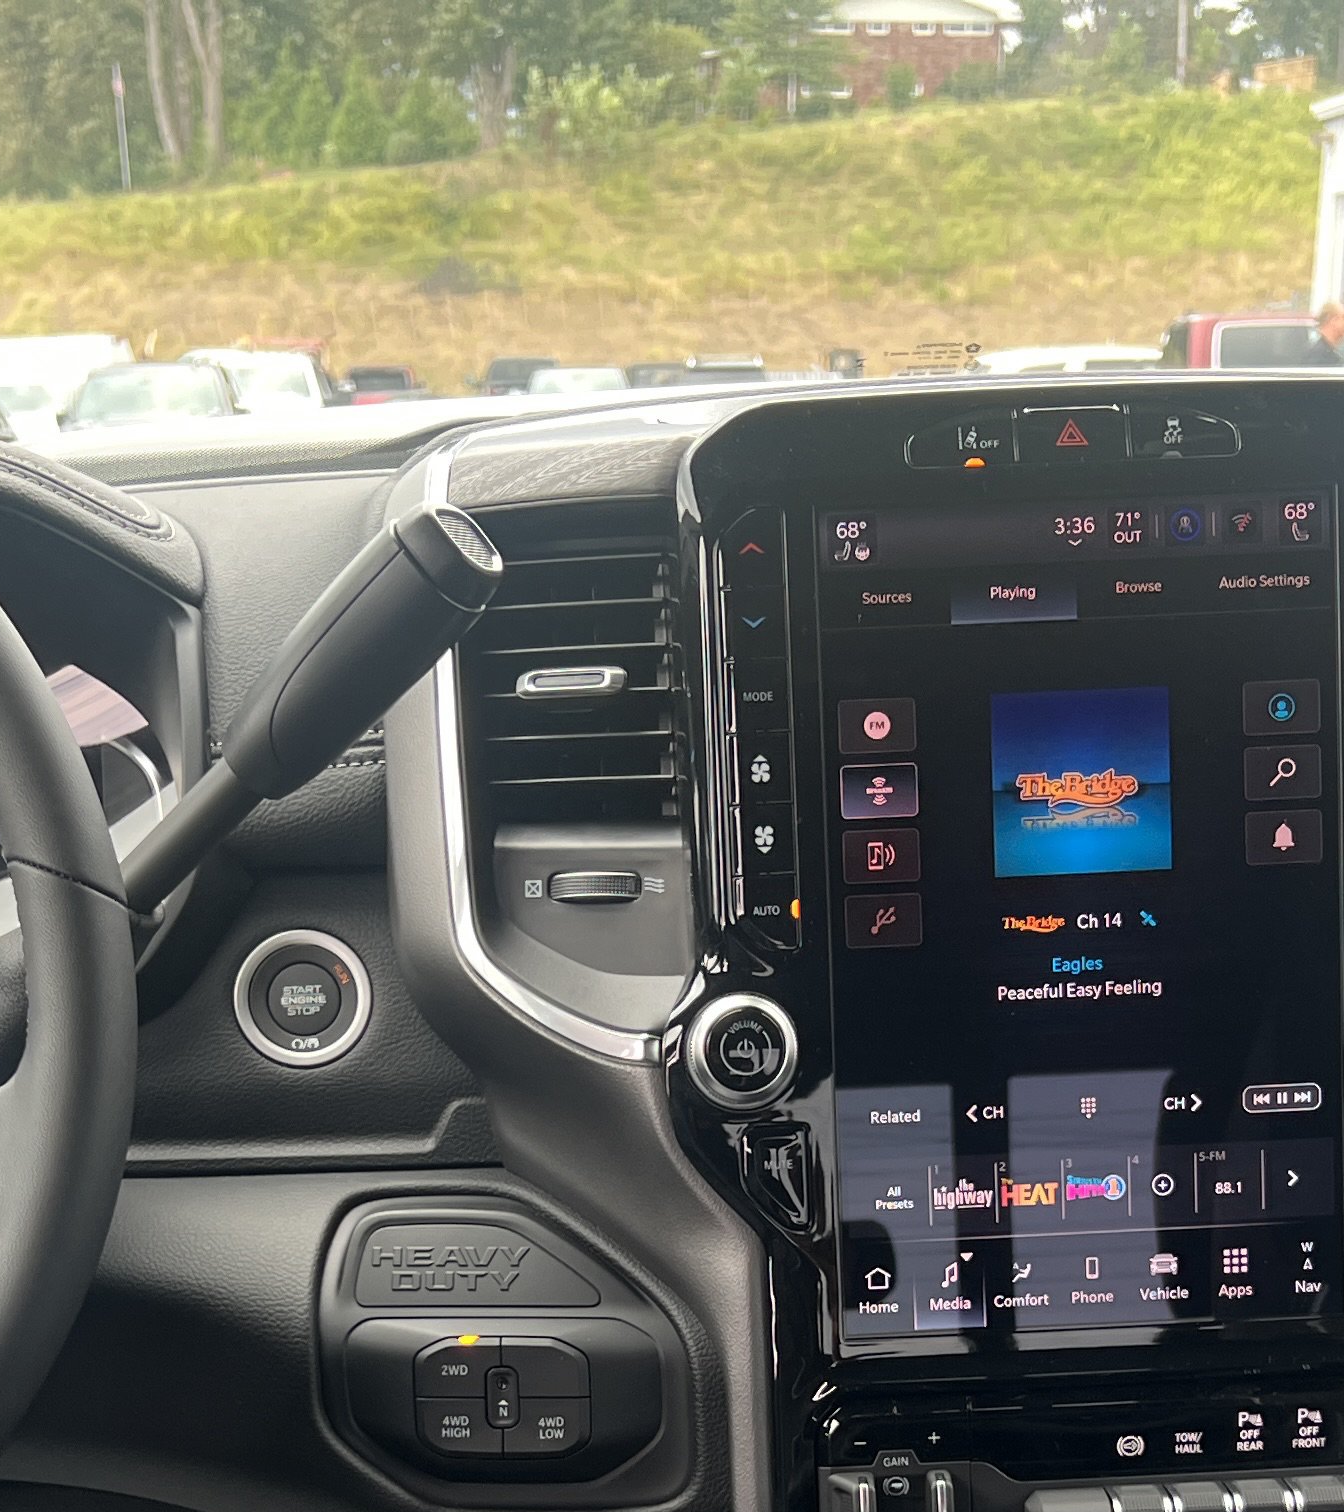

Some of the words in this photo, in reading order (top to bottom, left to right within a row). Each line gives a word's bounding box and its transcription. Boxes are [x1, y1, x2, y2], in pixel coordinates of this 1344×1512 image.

[980, 440, 999, 449] OFF
[1164, 436, 1183, 445] OFF
[1054, 517, 1095, 535] 3:36
[1114, 531, 1141, 543] OUT
[1116, 581, 1162, 594] Browse
[1219, 575, 1256, 589] Audio
[1259, 574, 1310, 588] Settings
[862, 591, 911, 604] Sources
[990, 586, 1036, 601] Playing
[743, 691, 773, 702] MODE
[870, 721, 884, 730] FM
[753, 905, 780, 916] AUTO
[1077, 914, 1098, 929] Ch
[1104, 913, 1122, 928] 14
[1052, 956, 1103, 974] Eagles
[283, 985, 322, 994] START
[997, 983, 1063, 1001] Peaceful
[1066, 982, 1102, 1000] Easy
[1105, 979, 1162, 997] Feeling
[281, 995, 326, 1004] ENGINE
[287, 1006, 320, 1016] STOP
[727, 1021, 764, 1034] VOLUME
[1164, 1097, 1185, 1110] CH
[870, 1109, 921, 1124] Related
[983, 1105, 1004, 1119] CH
[764, 1160, 794, 1170] MUTE
[999, 1162, 1006, 1172] 2
[959, 1179, 974, 1191] the
[1215, 1181, 1242, 1195] 88.1
[887, 1186, 901, 1197] All
[1001, 1182, 1059, 1207] HEAT
[933, 1187, 993, 1209] highway
[875, 1199, 914, 1210] Presets
[371, 1246, 531, 1267] HEAVY
[390, 1271, 521, 1292] DUTY
[1295, 1281, 1321, 1293] Nav
[1071, 1291, 1114, 1304] Phone
[1139, 1286, 1189, 1301] Vehicle
[1218, 1285, 1253, 1299] Apps
[930, 1297, 972, 1310] Media
[994, 1294, 1049, 1308] Comfort
[859, 1301, 899, 1314] Home
[441, 1365, 468, 1376] 2WD
[499, 1407, 507, 1417] N
[443, 1416, 469, 1427] 4WD
[538, 1417, 564, 1428] 4WD
[442, 1427, 470, 1439] HIGH
[539, 1428, 564, 1439] LOW
[1239, 1429, 1260, 1440] OFF
[1299, 1426, 1319, 1437] OFF
[1175, 1443, 1203, 1454] HAUL
[1236, 1440, 1264, 1451] REAR
[1292, 1437, 1326, 1449] FRONT
[883, 1457, 909, 1467] GAIN
